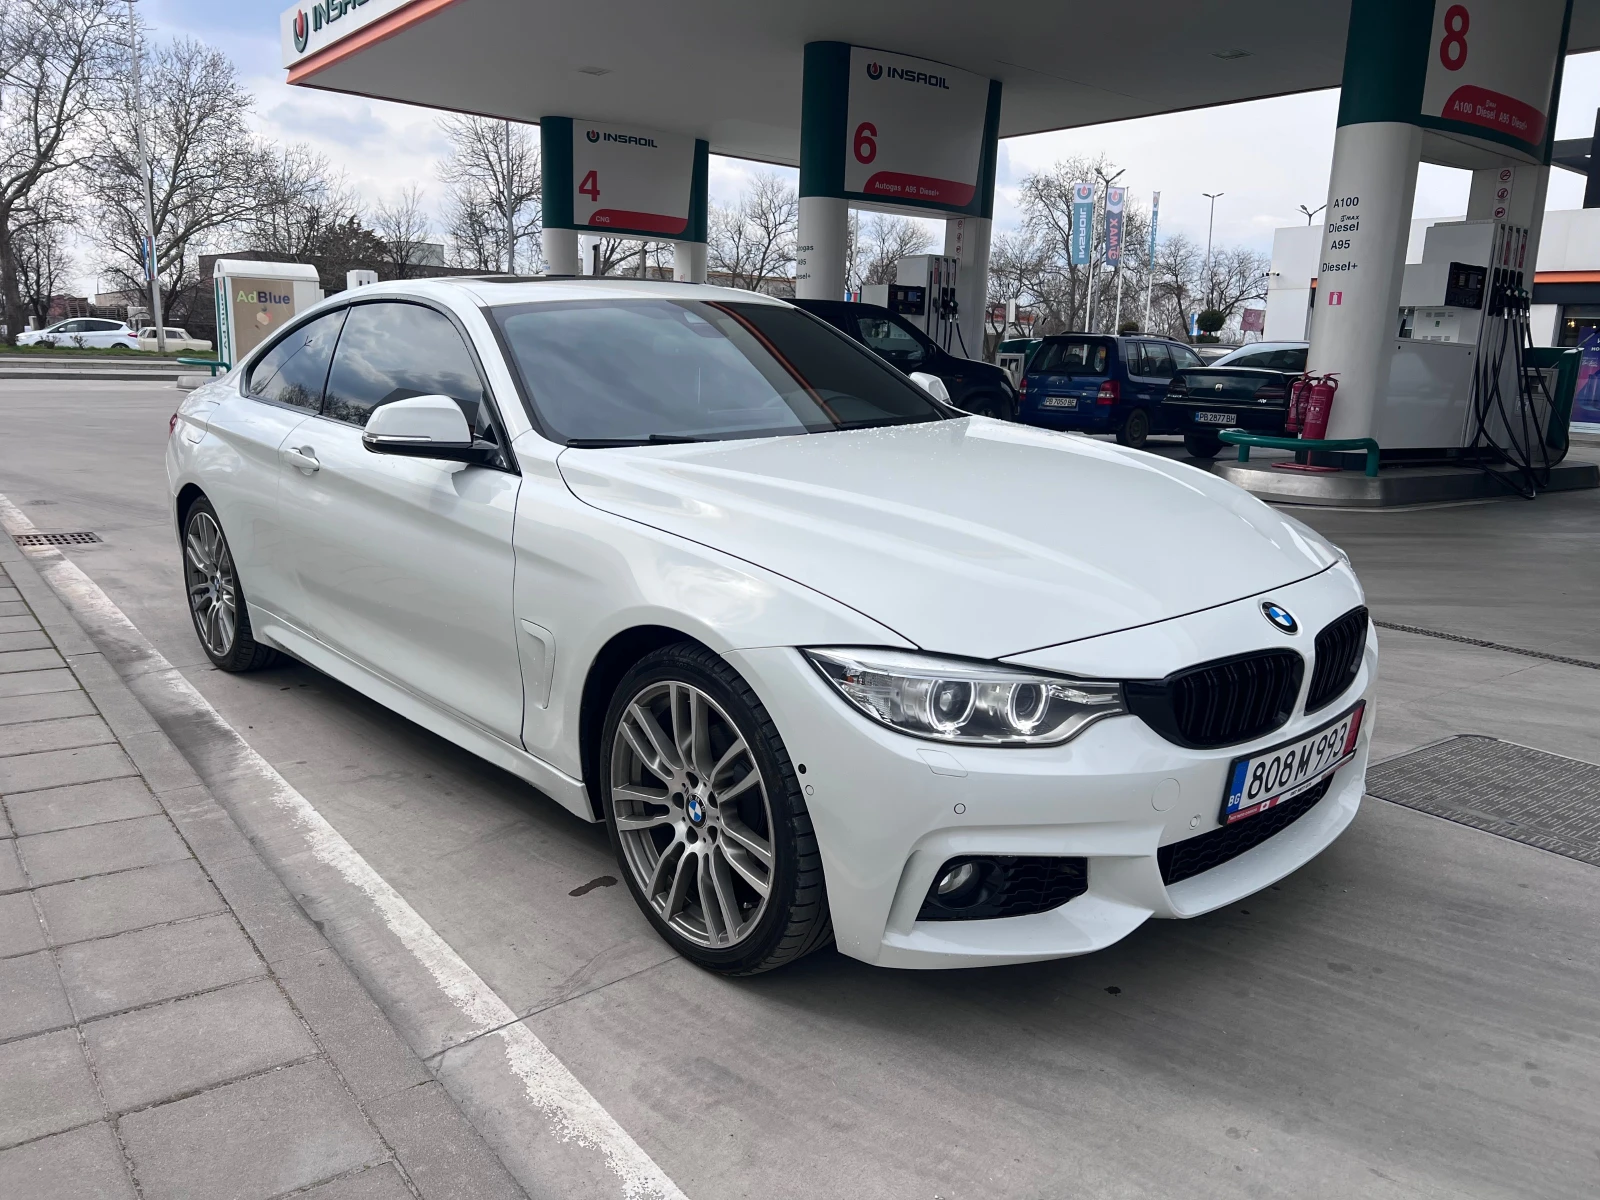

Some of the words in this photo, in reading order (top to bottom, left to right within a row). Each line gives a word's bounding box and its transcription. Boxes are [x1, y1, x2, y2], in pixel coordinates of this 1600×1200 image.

[1440, 4, 1470, 71] 8
[887, 66, 950, 90] INSAOIL
[1453, 100, 1473, 114] A100
[1475, 105, 1497, 120] Diesel
[603, 132, 658, 148] INSAOIL
[853, 121, 878, 165] 6
[578, 170, 600, 202] 4
[874, 181, 902, 193] Autogas
[904, 184, 917, 194] A95
[1333, 197, 1360, 209] A100
[595, 215, 610, 223] CNG
[1328, 221, 1360, 233] Diesel
[1330, 239, 1351, 250] A95
[1322, 261, 1358, 273] Diesel+
[236, 290, 291, 305] AdBlue
[1200, 412, 1209, 421] PB
[1209, 413, 1225, 423] 2877
[1226, 414, 1236, 424] BH
[1228, 793, 1241, 807] BG
